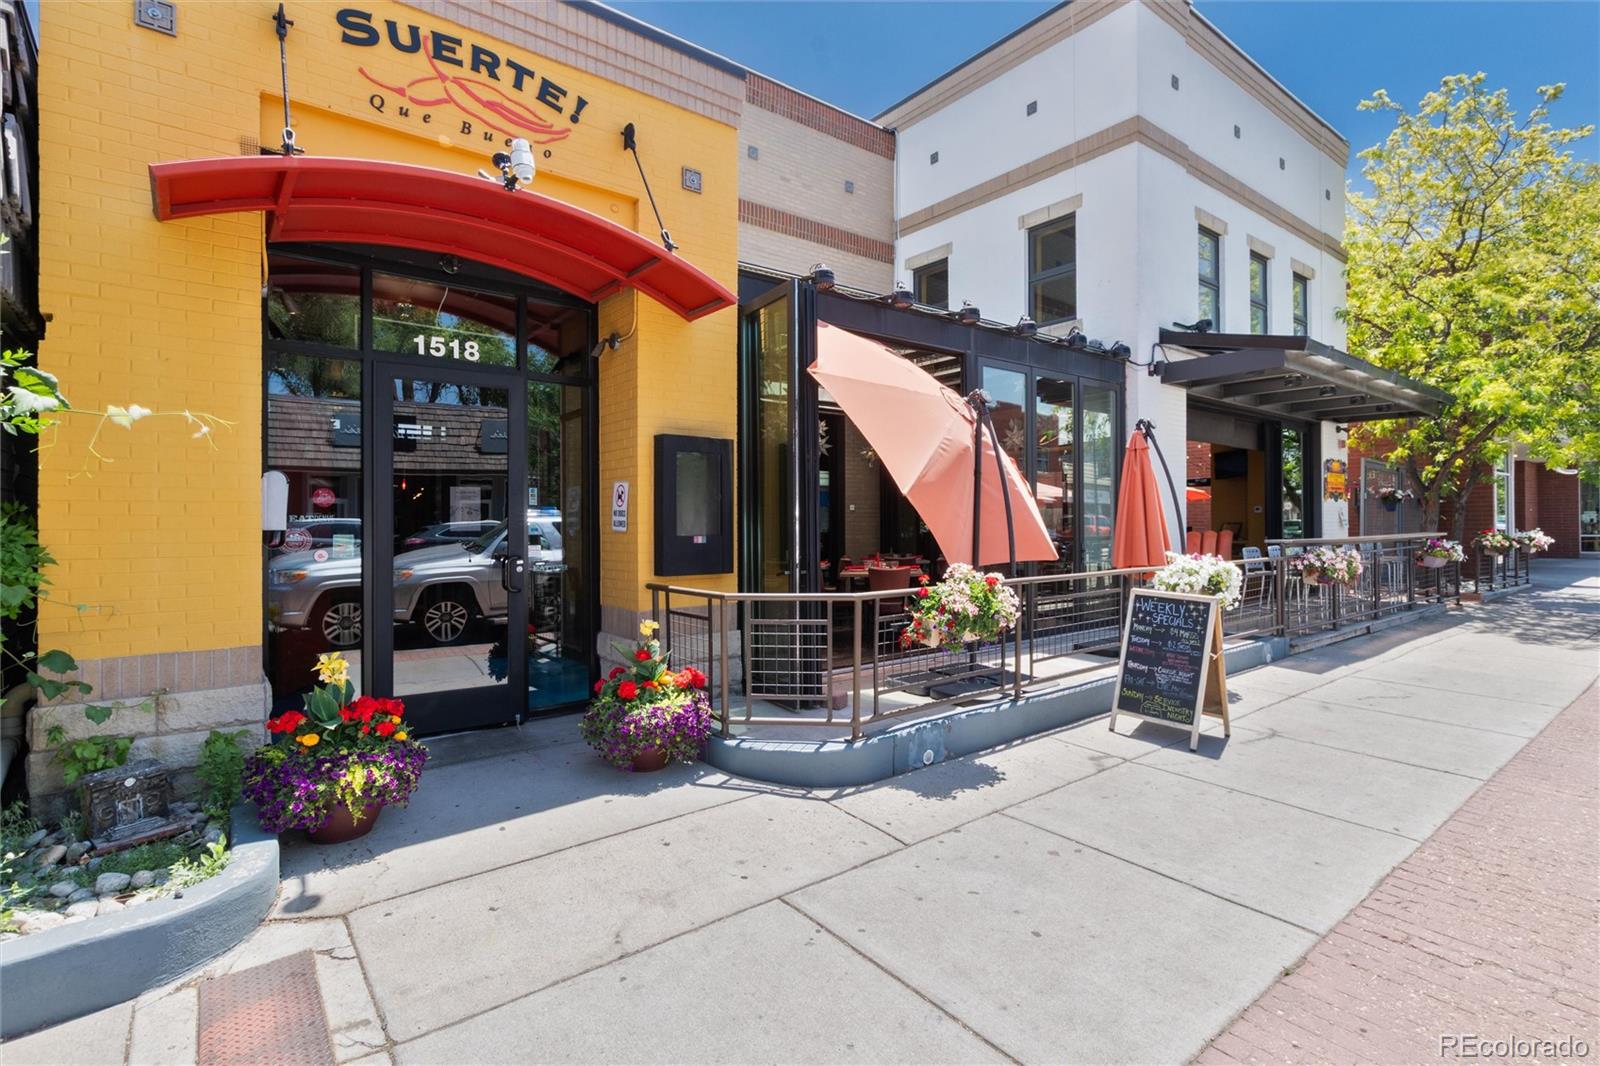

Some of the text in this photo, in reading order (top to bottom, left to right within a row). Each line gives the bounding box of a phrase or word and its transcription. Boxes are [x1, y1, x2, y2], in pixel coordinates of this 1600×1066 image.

[336, 8, 589, 124] SUERTE!
[369, 93, 552, 158] Que Bueo
[413, 334, 480, 361] 1518
[1141, 598, 1186, 618] WEEKLY
[1152, 613, 1194, 629] SPECIALS
